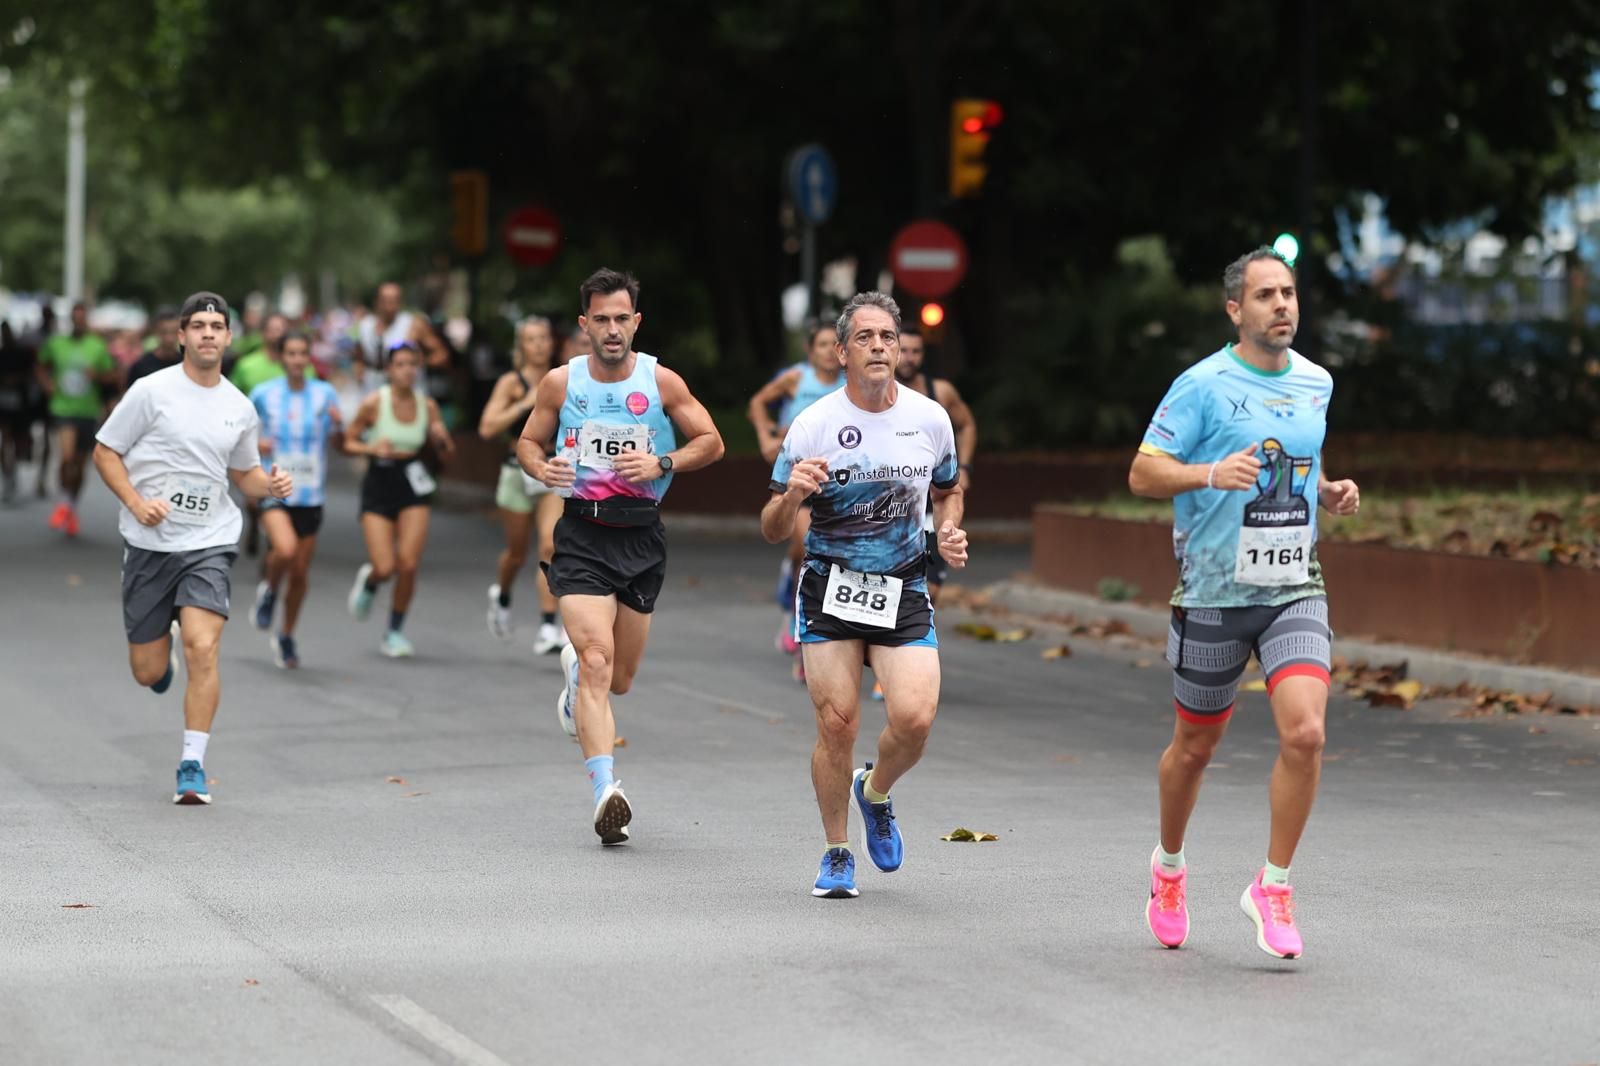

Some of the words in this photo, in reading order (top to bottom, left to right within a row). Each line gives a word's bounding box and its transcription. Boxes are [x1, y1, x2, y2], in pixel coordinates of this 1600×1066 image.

[853, 465, 928, 480] instalHOME
[170, 492, 210, 511] 455
[1246, 546, 1303, 565] 1164
[835, 584, 888, 611] 848
